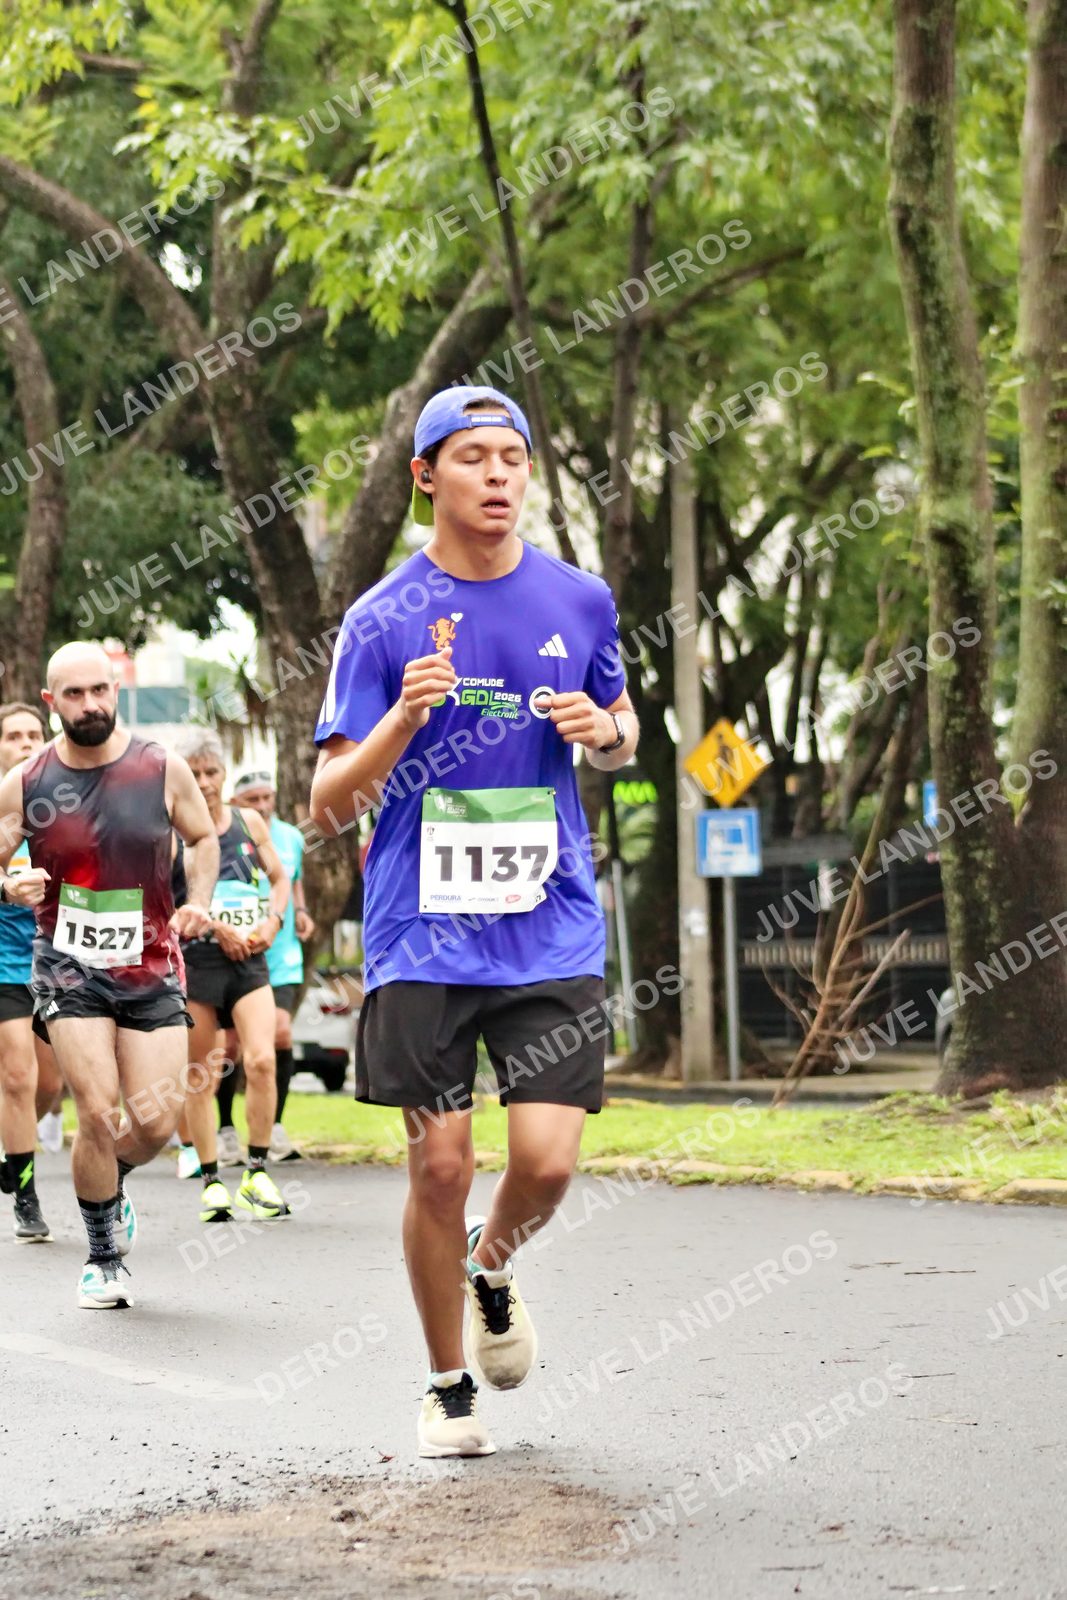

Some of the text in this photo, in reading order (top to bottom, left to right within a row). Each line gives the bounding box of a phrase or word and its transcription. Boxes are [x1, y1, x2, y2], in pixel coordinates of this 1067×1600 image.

[463, 678, 504, 687] COMUDE
[461, 689, 521, 706] GDL 2026
[434, 846, 549, 883] 1137
[66, 921, 137, 951] 1527
